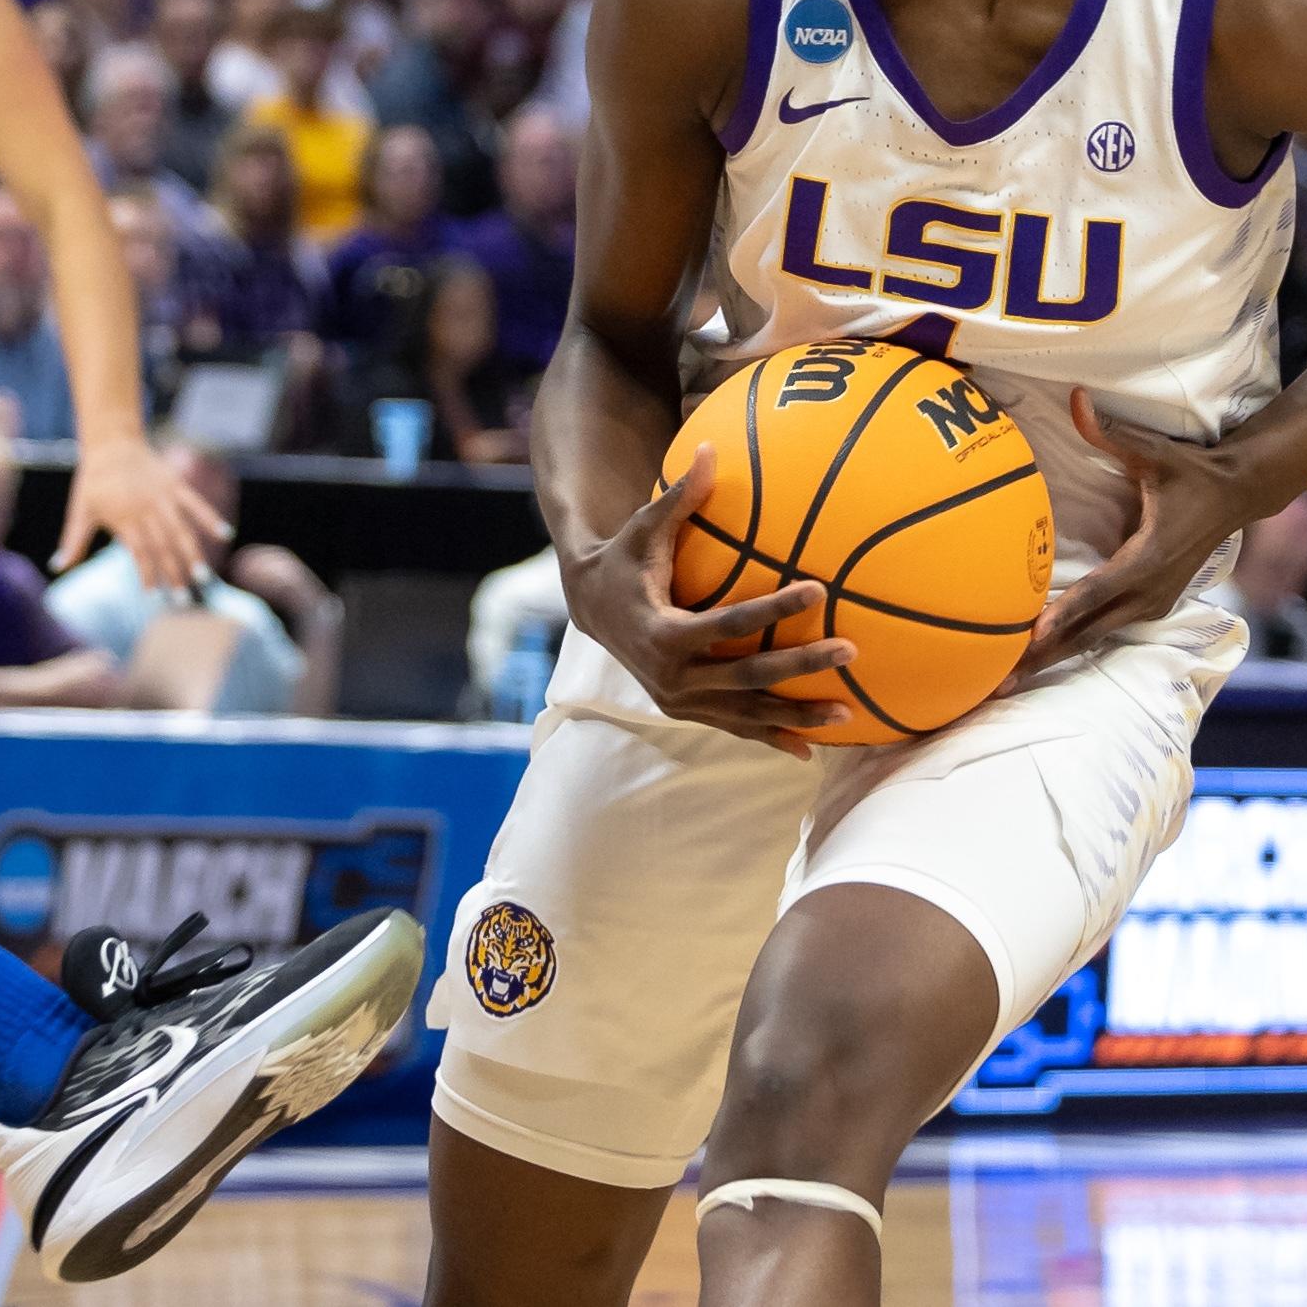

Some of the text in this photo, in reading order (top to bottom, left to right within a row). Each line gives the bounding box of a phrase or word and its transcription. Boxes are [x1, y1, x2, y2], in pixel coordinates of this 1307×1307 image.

[794, 27, 848, 46] NCAA
[1088, 123, 1135, 171] SEC
[778, 173, 1126, 326] LSU
